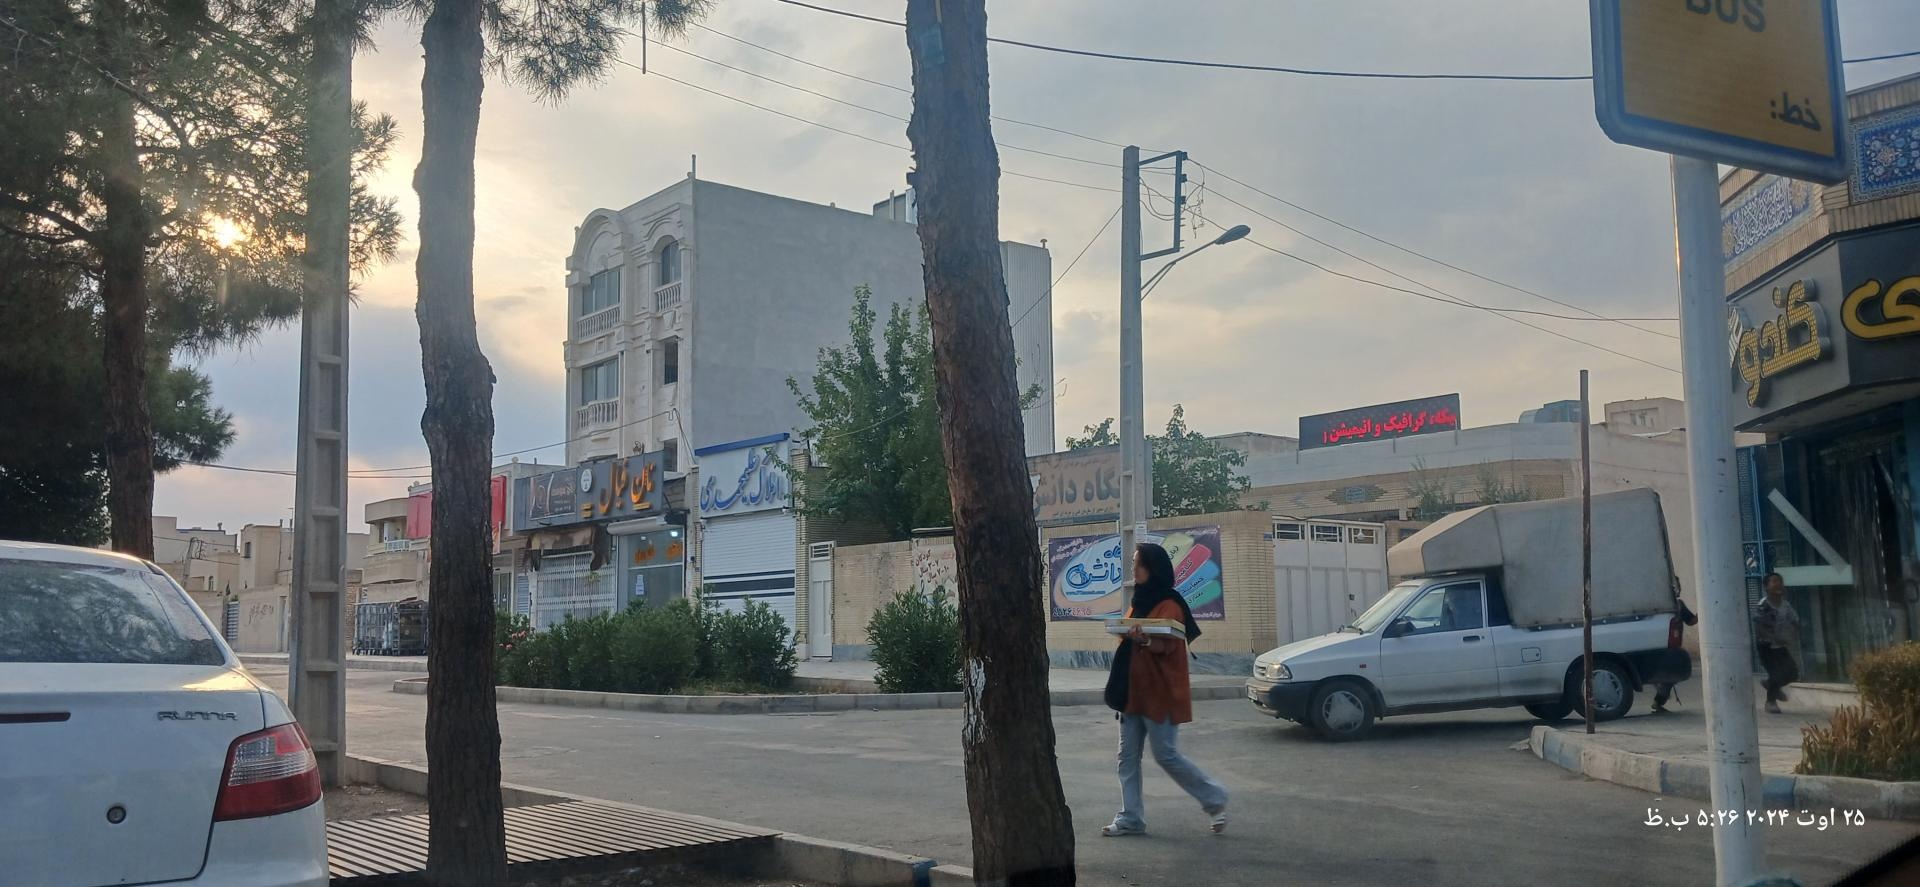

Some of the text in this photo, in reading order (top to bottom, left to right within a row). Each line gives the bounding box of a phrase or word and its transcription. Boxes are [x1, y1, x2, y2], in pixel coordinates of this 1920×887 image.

[1770, 91, 1822, 131] خط:
[1738, 279, 1824, 408] کندو
[157, 710, 238, 721] RUNNA
